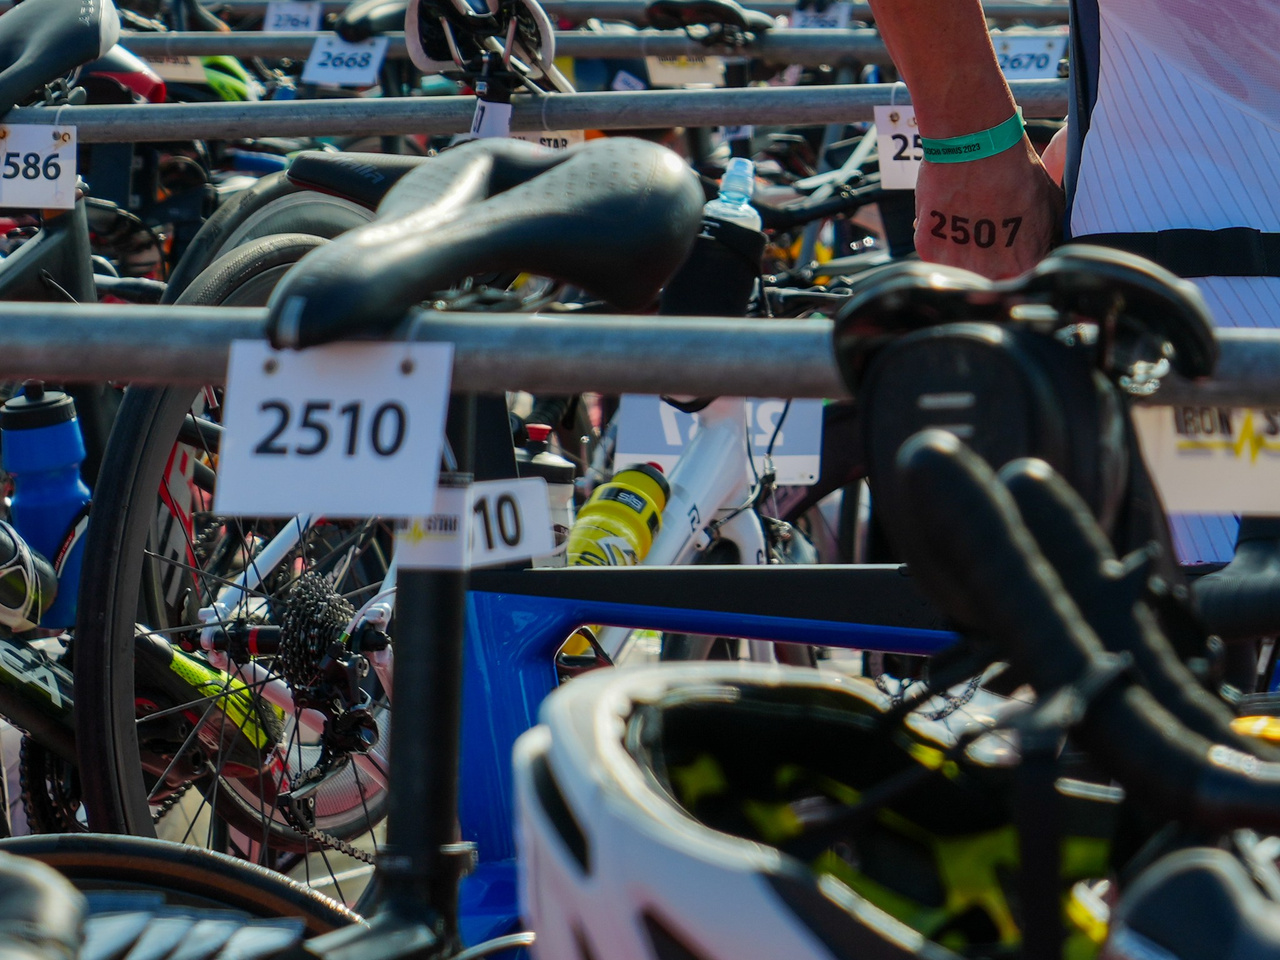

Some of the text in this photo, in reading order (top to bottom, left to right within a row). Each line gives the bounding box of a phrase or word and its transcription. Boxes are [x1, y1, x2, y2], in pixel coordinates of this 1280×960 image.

[318, 51, 372, 68] 2668
[1000, 52, 1050, 70] 2670
[963, 143, 981, 153] 2023
[2, 152, 61, 180] 586
[929, 209, 1023, 249] 2507
[253, 400, 407, 457] 2510
[1173, 406, 1233, 436] IRON
